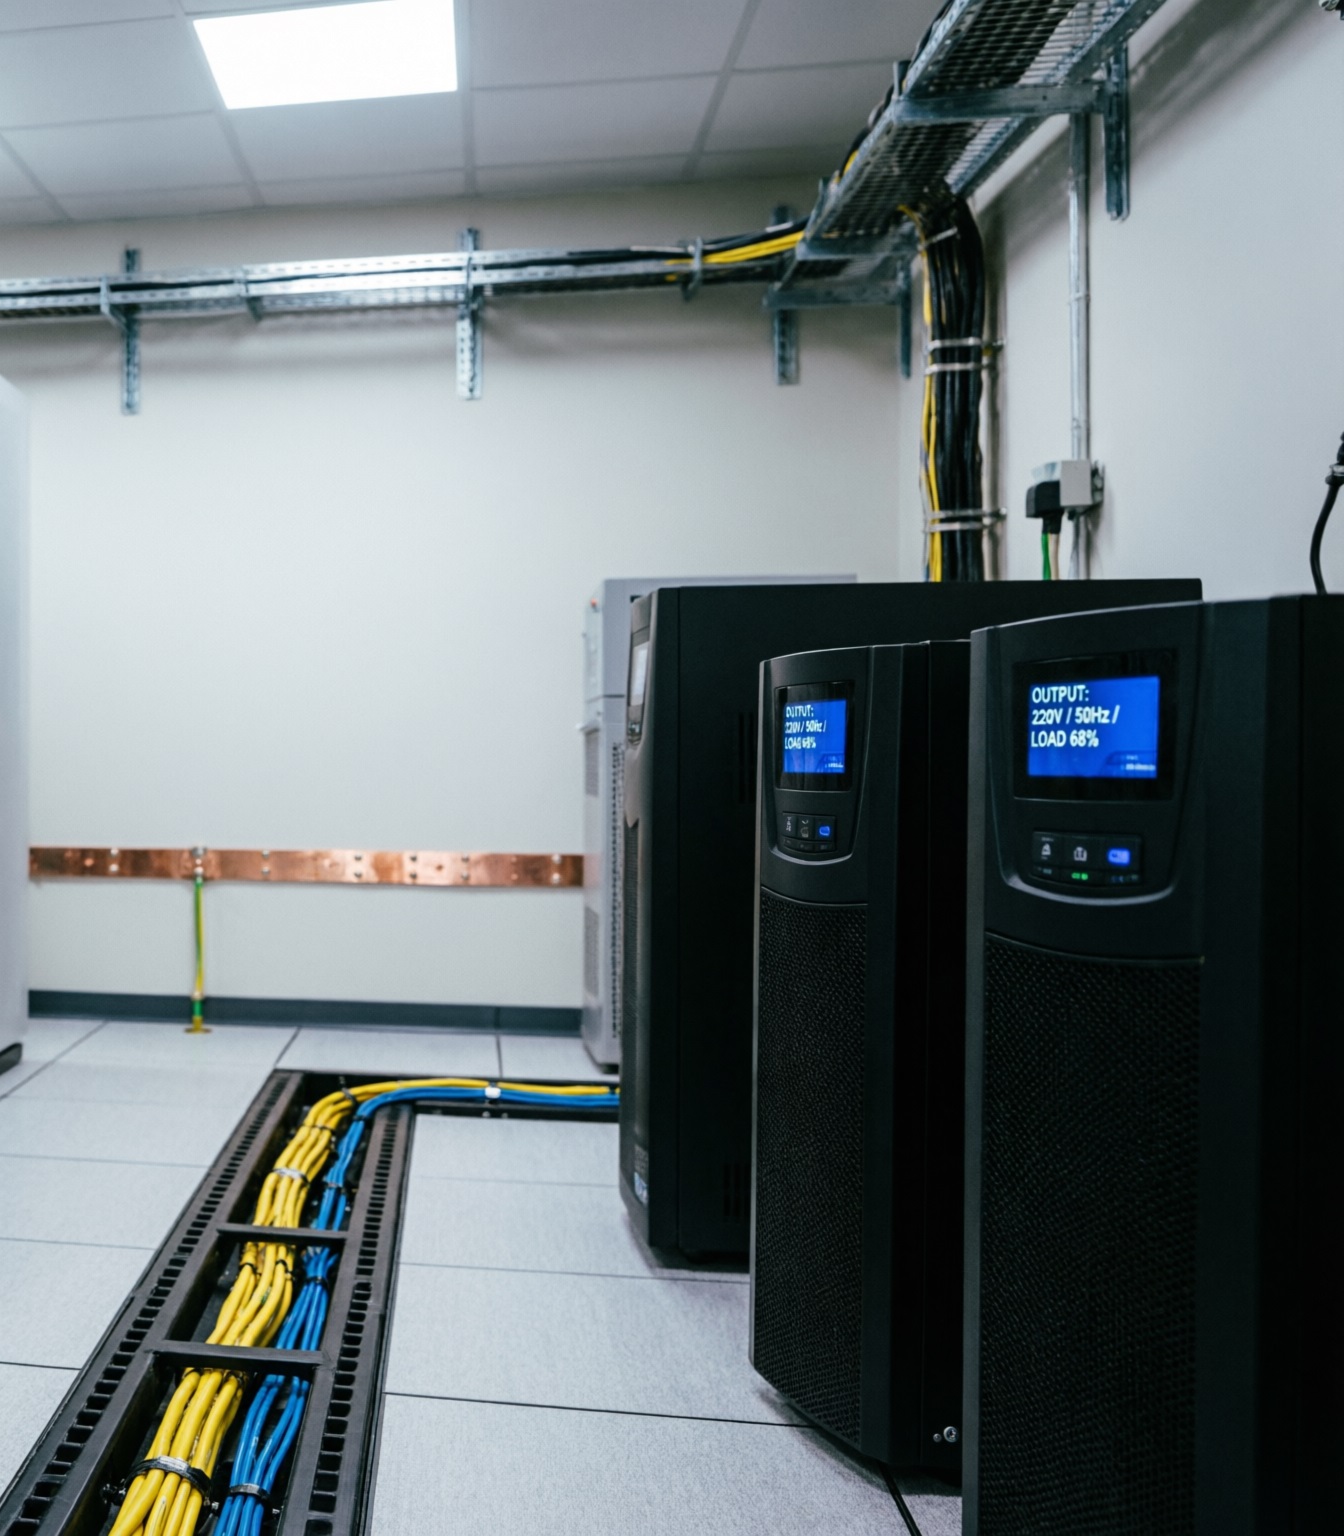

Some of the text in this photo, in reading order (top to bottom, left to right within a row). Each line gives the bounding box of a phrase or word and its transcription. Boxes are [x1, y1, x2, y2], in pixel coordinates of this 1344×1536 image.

[1032, 684, 1090, 703] OUTPUT:
[1031, 704, 1121, 725] 220V / 50Hz /
[1030, 729, 1099, 748] LOAD 68%
